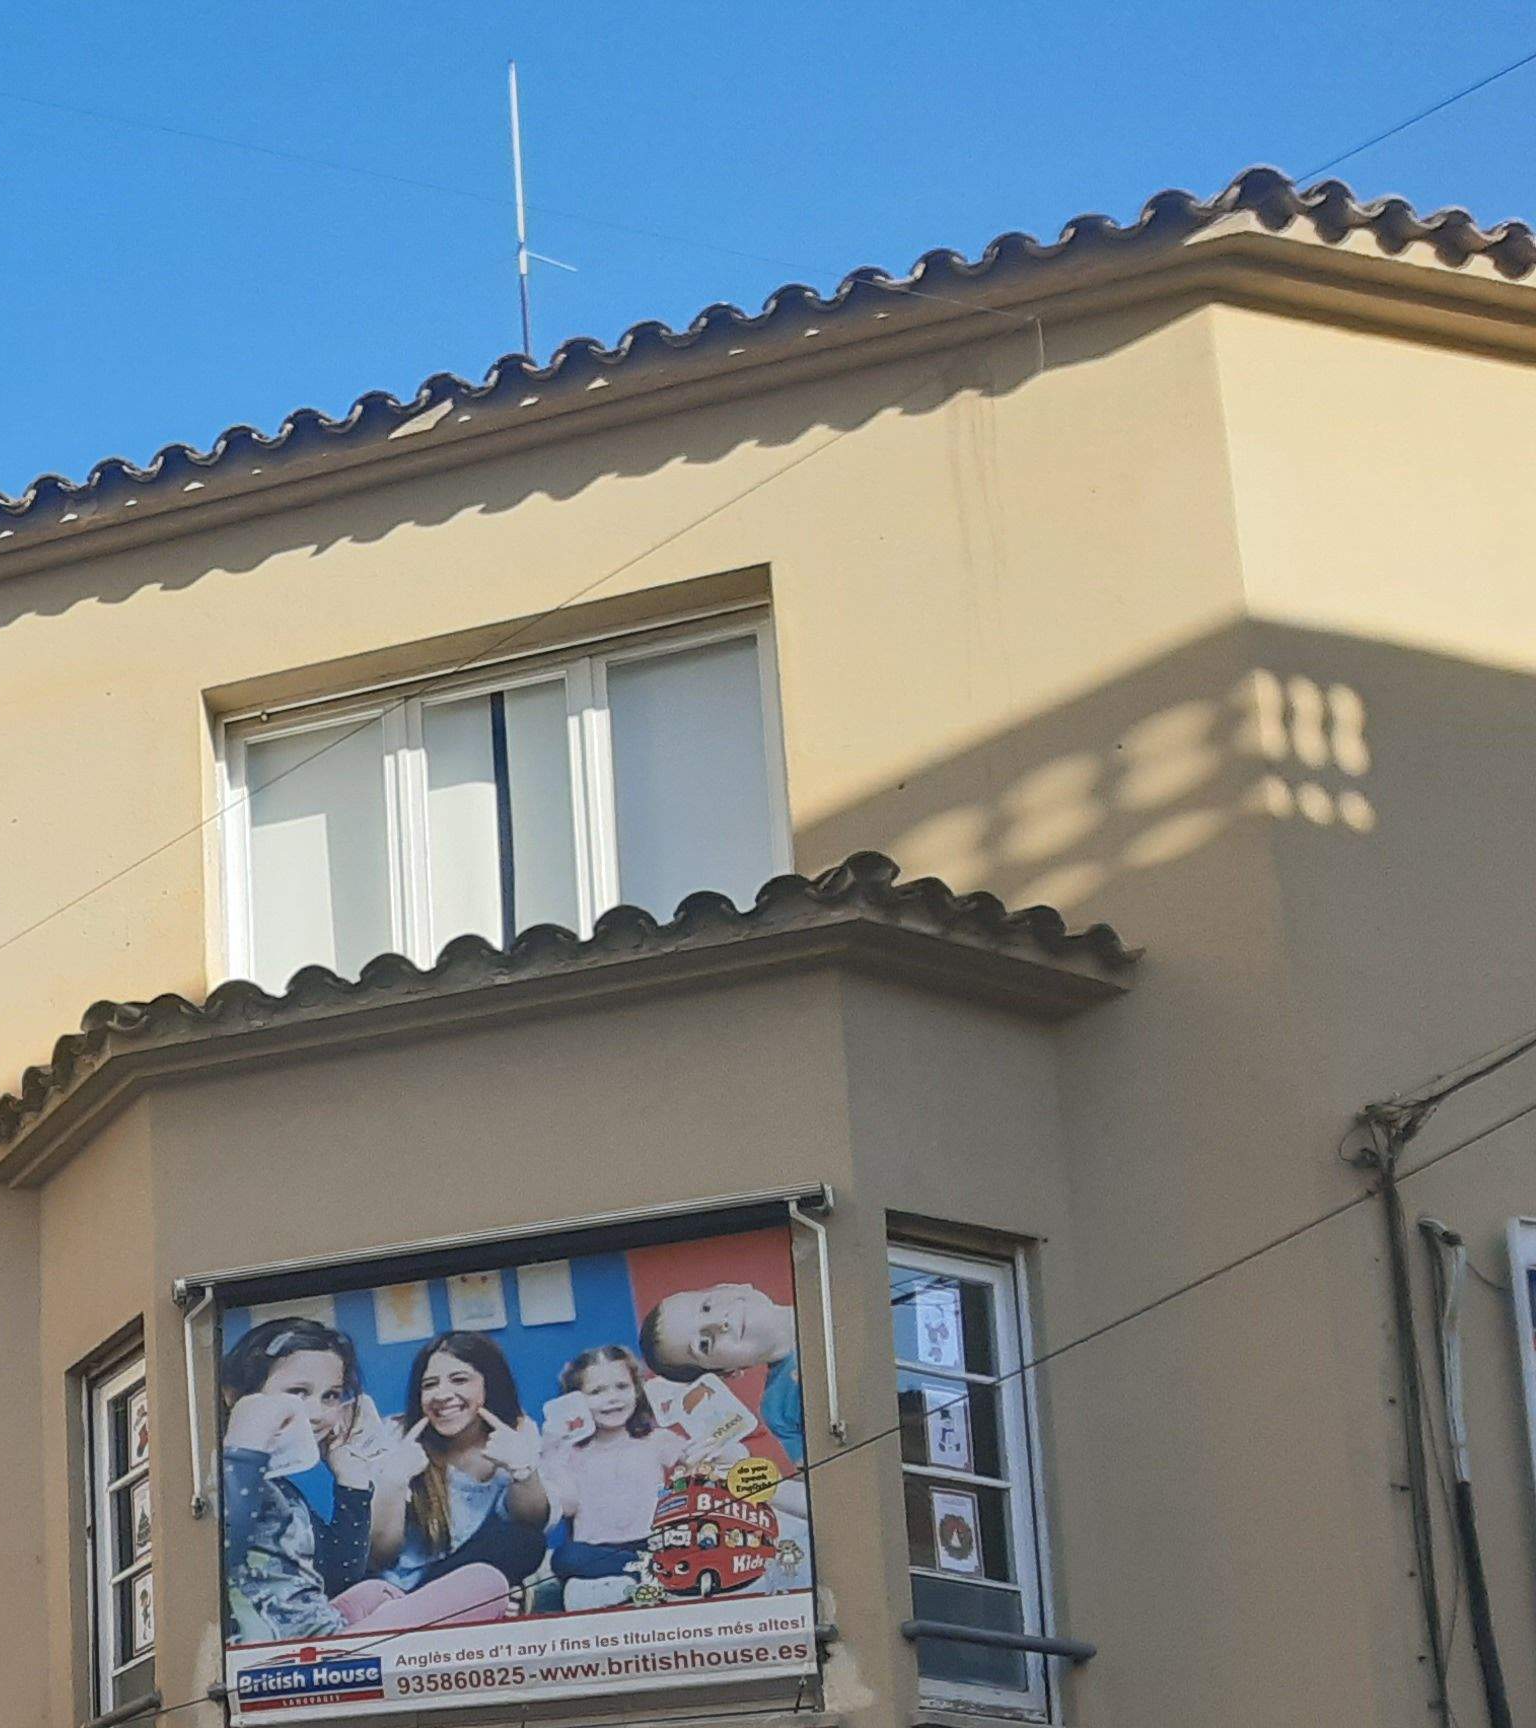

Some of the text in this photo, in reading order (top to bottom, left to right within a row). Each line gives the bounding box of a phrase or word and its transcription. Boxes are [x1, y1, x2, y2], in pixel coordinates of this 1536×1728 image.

[697, 1493, 771, 1528] British
[395, 1651, 451, 1669] Anglès
[456, 1650, 484, 1661] des
[517, 1643, 547, 1657] any
[560, 1637, 591, 1651] fins
[595, 1635, 620, 1648] les
[623, 1626, 714, 1646] titulacions
[717, 1623, 754, 1637] més
[757, 1615, 806, 1633] altes!
[239, 1666, 380, 1694] British House
